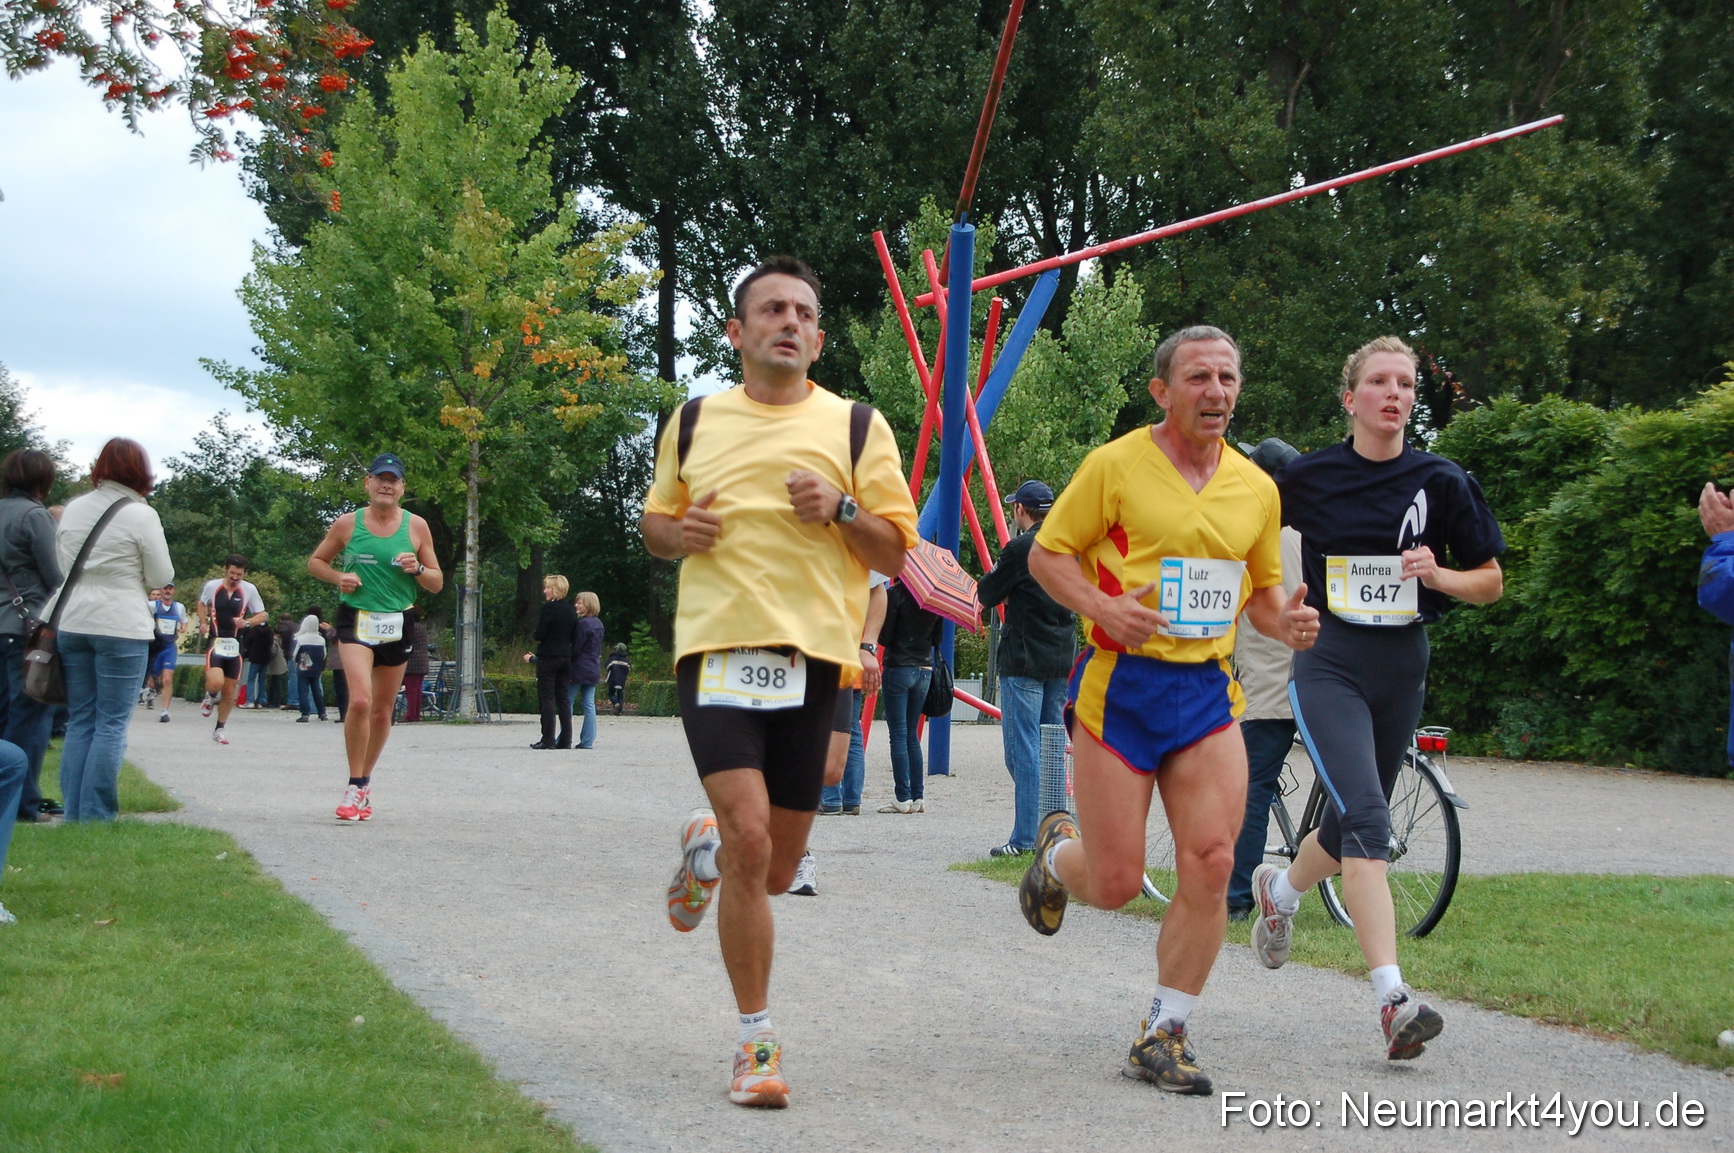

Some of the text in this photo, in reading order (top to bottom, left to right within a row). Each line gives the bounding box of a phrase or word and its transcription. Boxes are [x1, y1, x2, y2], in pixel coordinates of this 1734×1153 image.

[1189, 566, 1209, 580] Lutz
[1351, 563, 1391, 576] Andrea
[1167, 587, 1173, 597] A
[1360, 584, 1401, 602] 647
[1188, 590, 1231, 609] 3079
[375, 624, 395, 634] 128
[707, 658, 714, 668] B
[740, 665, 787, 689] 398
